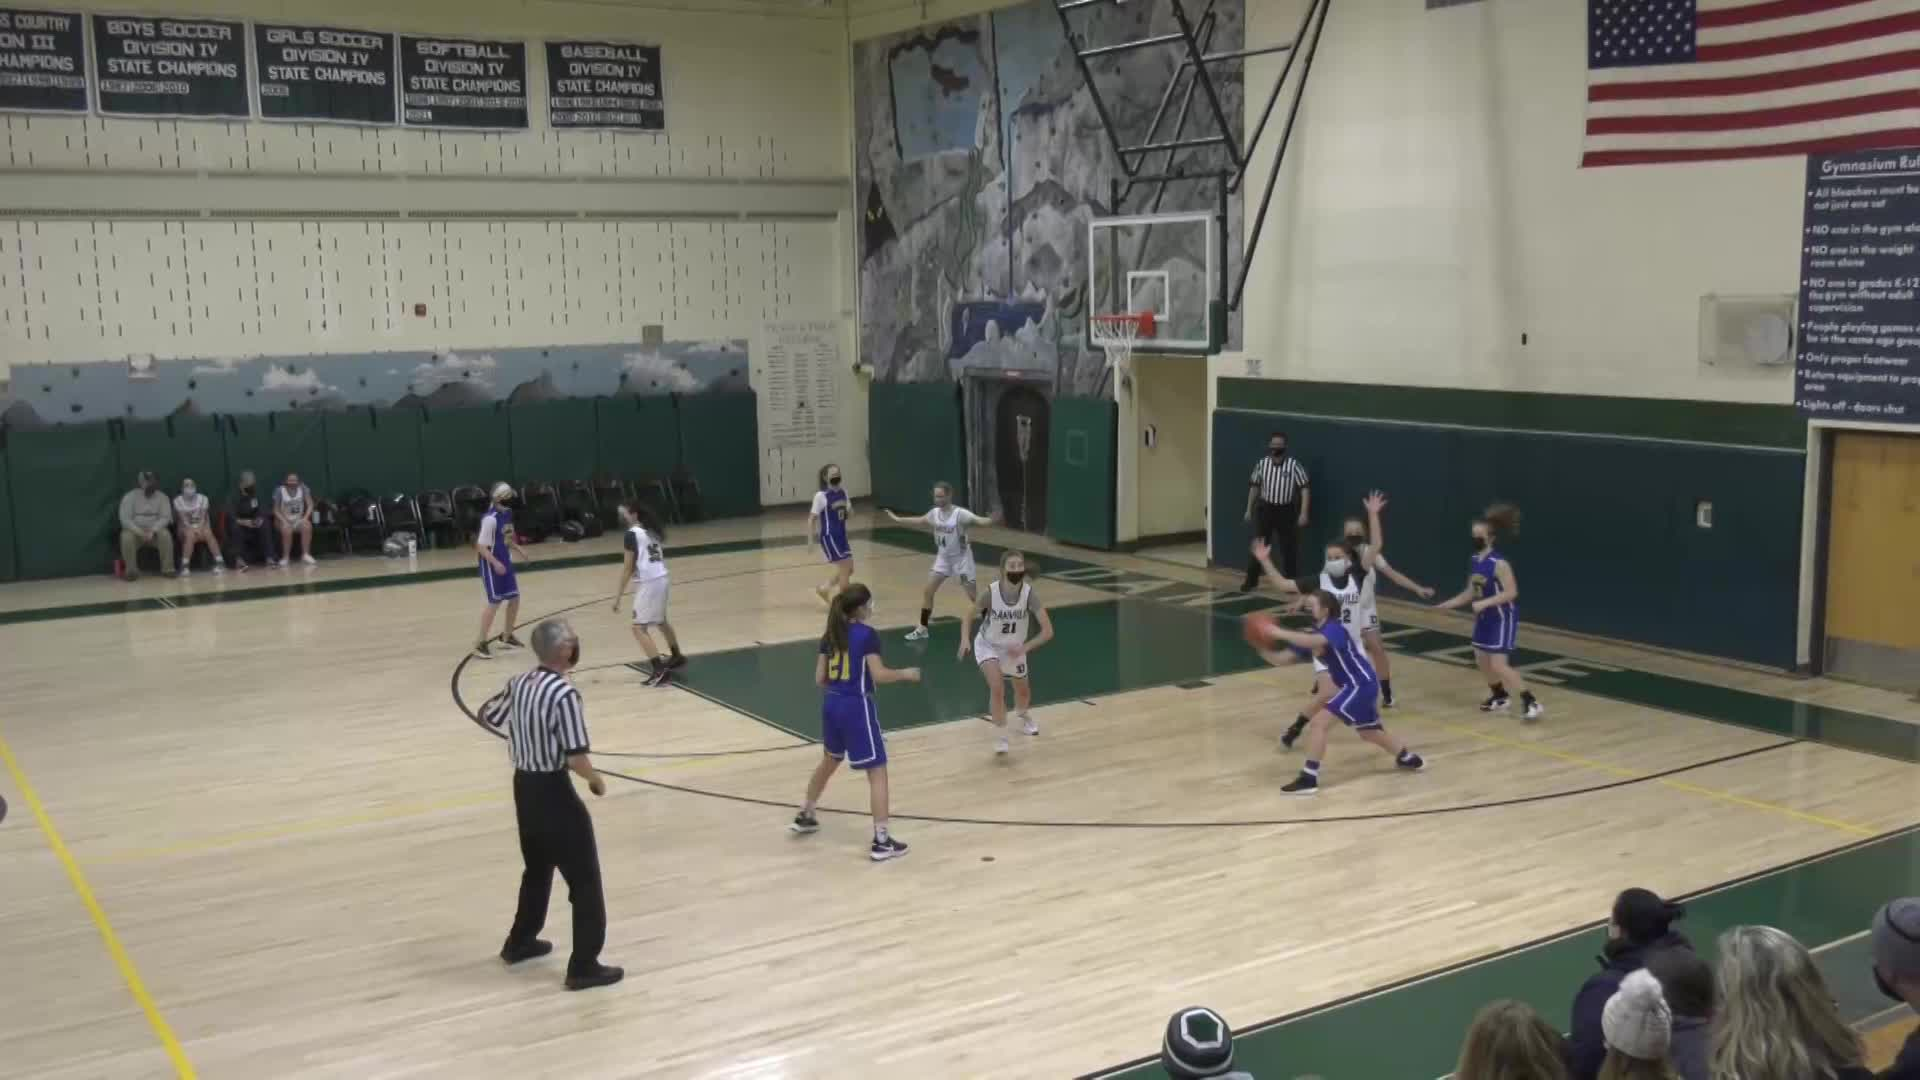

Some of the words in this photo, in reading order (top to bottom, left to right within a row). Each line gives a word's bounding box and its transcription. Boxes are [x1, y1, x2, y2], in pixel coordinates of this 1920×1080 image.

[15, 14, 70, 32] COUNTRY
[106, 20, 154, 37] BOYS
[161, 22, 231, 40] SOCCER
[31, 34, 55, 50] III
[266, 29, 314, 44] GIRLS
[319, 31, 383, 50] SOCCER
[123, 40, 194, 57] DIVISION
[200, 43, 217, 57] IV
[282, 48, 347, 64] DIVISION
[352, 52, 368, 65] IV
[416, 42, 511, 59] SOFTBALL
[561, 45, 648, 63] BASEBALL
[107, 58, 152, 74] STATE
[157, 60, 237, 78] CHAMPIONS
[425, 59, 483, 76] DIVISION
[488, 63, 504, 75] IV
[569, 63, 625, 78] DIVISION
[628, 65, 641, 78] IV
[268, 66, 310, 80] STATE
[314, 67, 386, 86] CHAMPIONS
[410, 76, 449, 91] STATE
[452, 79, 521, 93] CHAMPIONS
[557, 79, 592, 93] STATE
[595, 80, 655, 96] CHAMPIONS
[1822, 157, 1897, 175] Gymnasium
[1831, 184, 1877, 198] bleachers
[1812, 225, 1829, 235] NO
[1850, 223, 1861, 233] in
[1862, 223, 1878, 233] the
[1879, 225, 1903, 236] gym
[1811, 244, 1828, 255] NO
[1829, 246, 1849, 255] one
[1849, 243, 1860, 254] in
[1861, 244, 1877, 254] the
[1879, 243, 1914, 256] weight
[1837, 257, 1866, 267] alone
[1809, 278, 1826, 288] NO
[1827, 280, 1846, 288] one
[1847, 277, 1857, 288] in
[1858, 277, 1893, 291] grades
[1894, 277, 1920, 288] K-12
[1824, 291, 1847, 301] gym
[1848, 289, 1887, 300] without
[1887, 289, 1914, 300] adult
[1808, 303, 1864, 313] supervision
[1807, 321, 1840, 333] People
[1840, 321, 1879, 334] playing
[1879, 324, 1914, 334] games
[1830, 334, 1846, 344] the
[1847, 336, 1874, 345] same
[1875, 337, 1895, 348] age
[1806, 352, 1829, 366] Only
[1830, 354, 1863, 366] proper
[1863, 354, 1909, 366] footwear
[1804, 369, 1836, 380] Return
[1836, 372, 1888, 383] equipment
[1889, 374, 1900, 383] to
[1802, 399, 1831, 411] Lights
[1832, 400, 1847, 411] off
[1853, 402, 1881, 412] doors
[1883, 403, 1905, 414] shut
[1001, 622, 1017, 635] 21
[829, 650, 850, 680] 21
